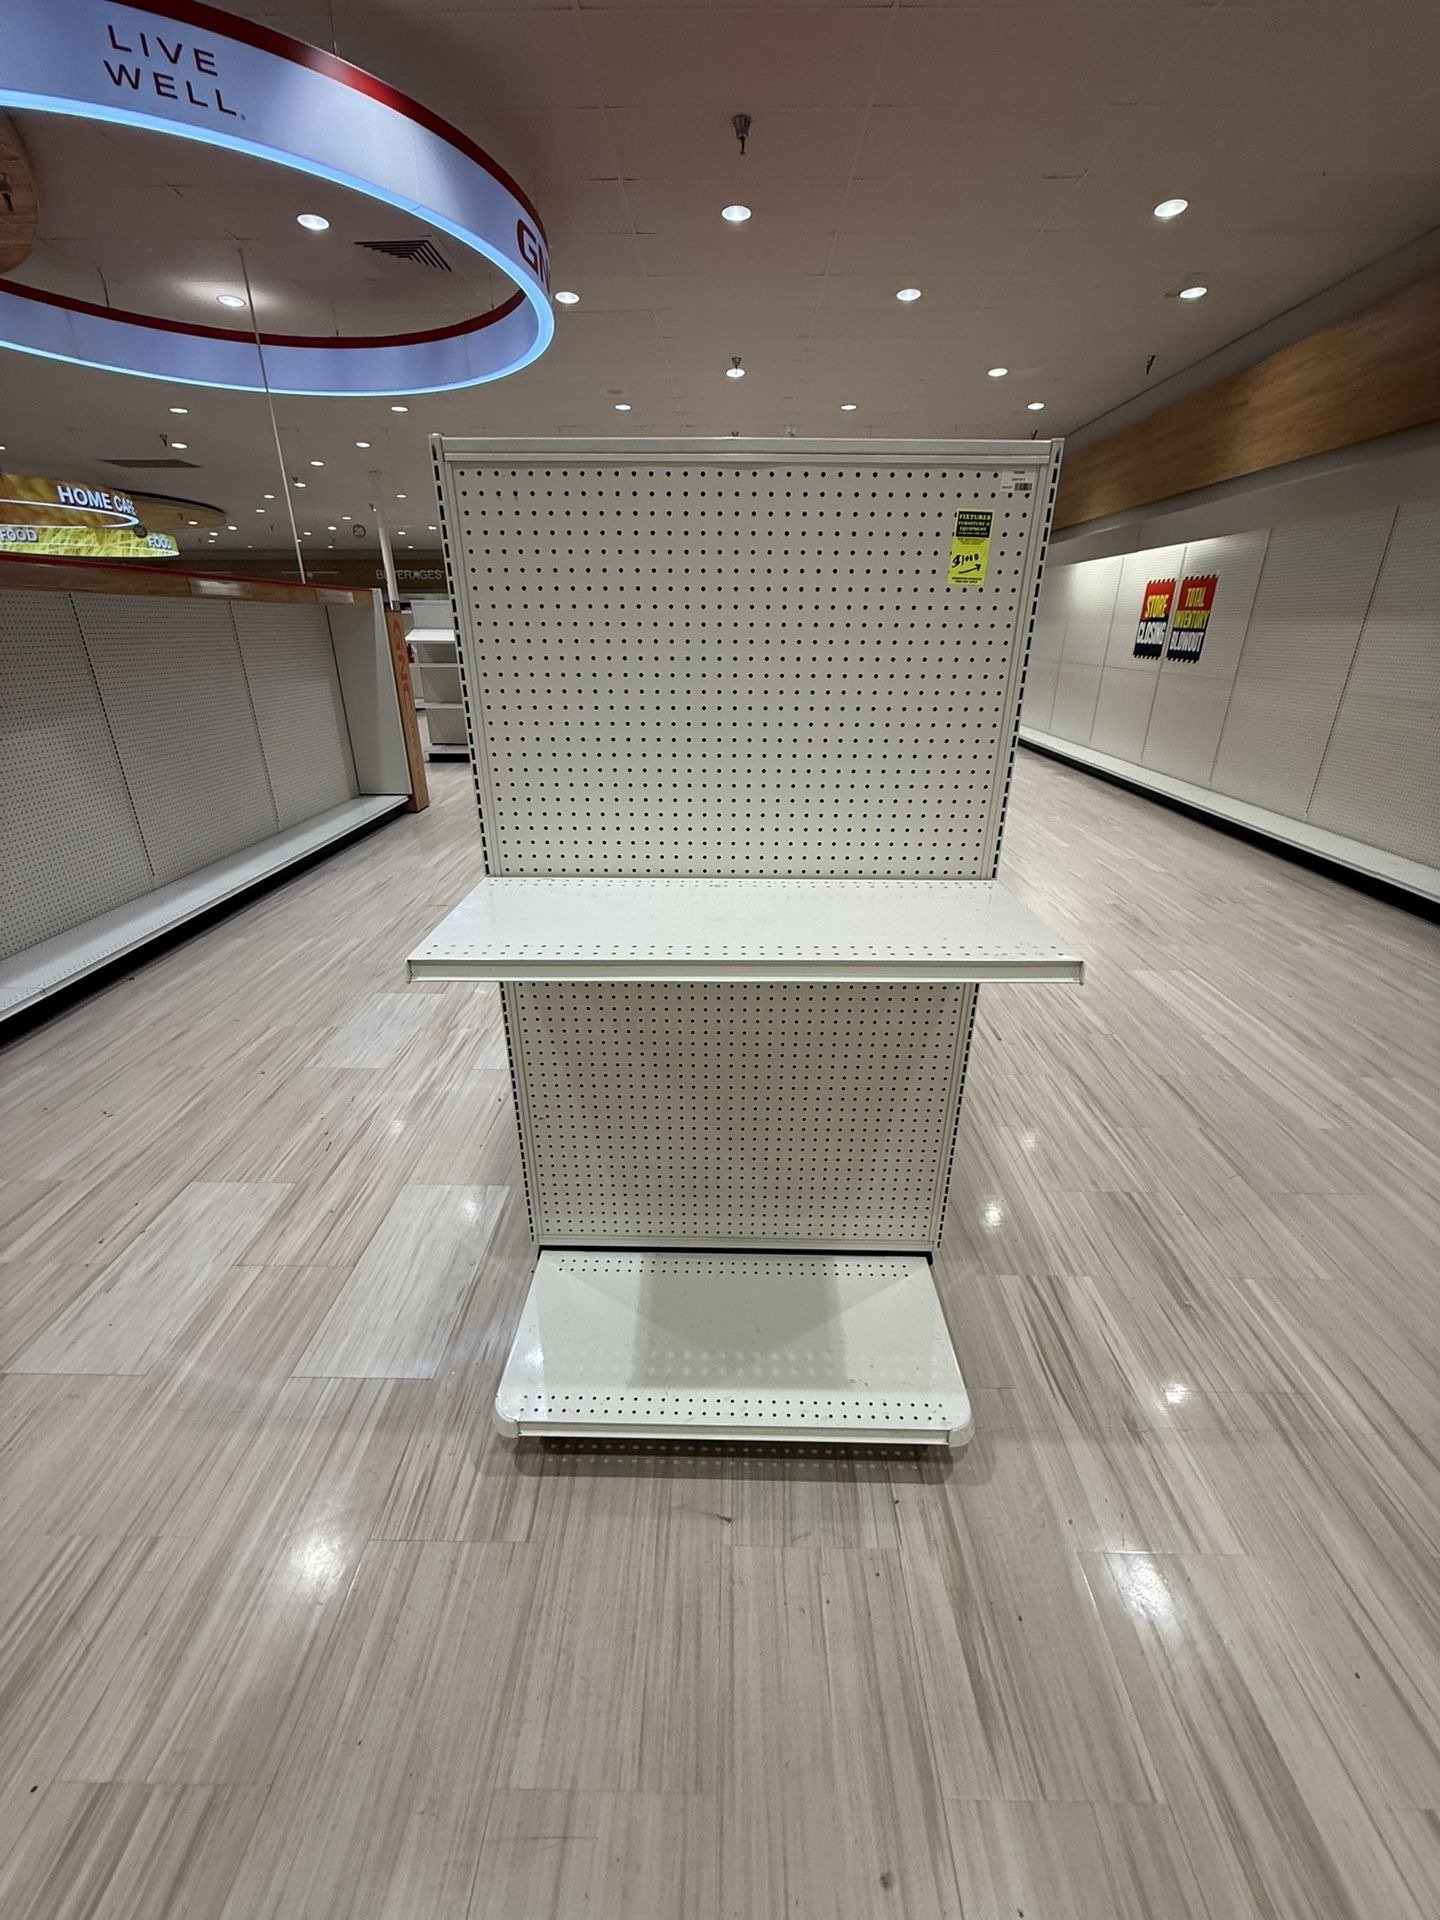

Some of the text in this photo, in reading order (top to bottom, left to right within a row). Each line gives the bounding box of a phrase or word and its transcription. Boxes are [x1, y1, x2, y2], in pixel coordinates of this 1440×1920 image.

[107, 24, 218, 77] LIVE
[57, 485, 113, 510] HOME
[0, 529, 38, 542] FOOD
[376, 569, 442, 580] BERAGES
[1144, 594, 1170, 618] STORE
[1185, 587, 1207, 607] TOTAL
[1173, 610, 1211, 629] INVENTORY
[1136, 621, 1167, 645] CLOSING
[1169, 631, 1205, 652] BLOWOUT
